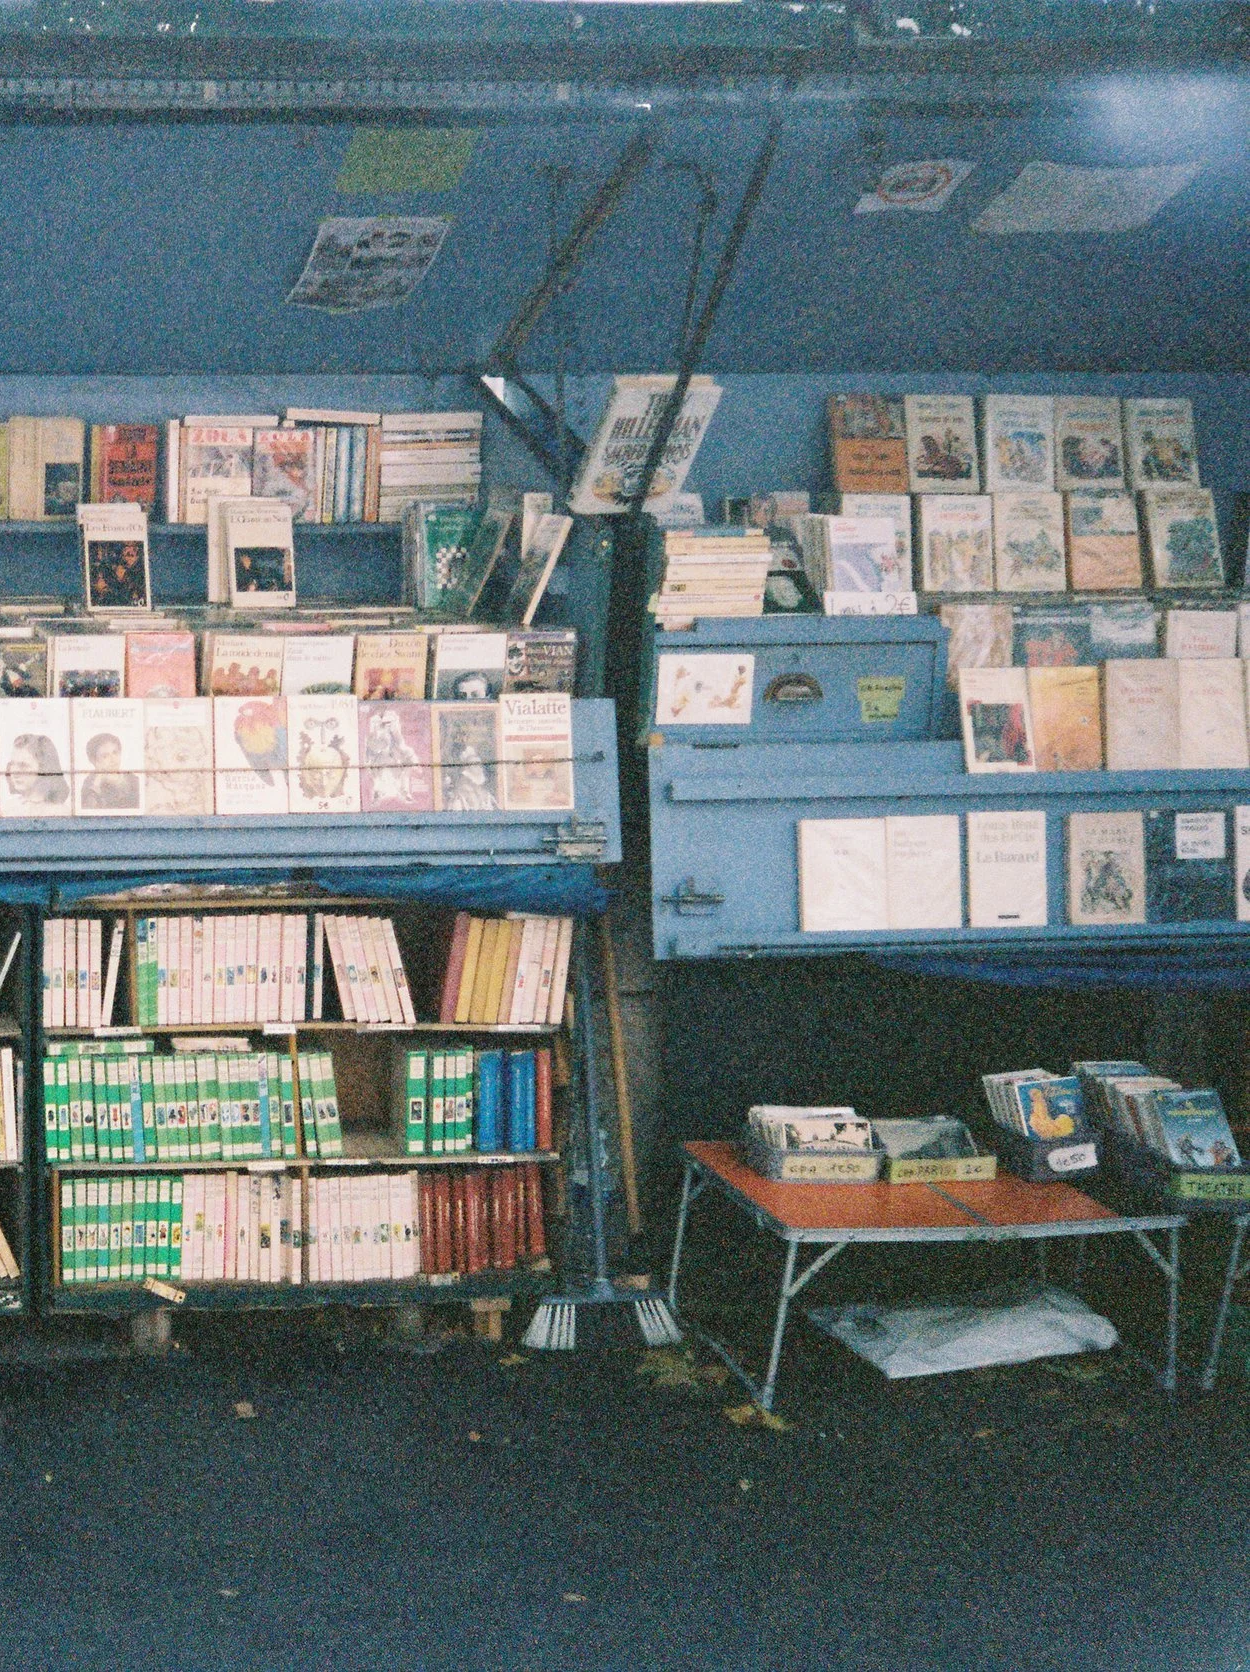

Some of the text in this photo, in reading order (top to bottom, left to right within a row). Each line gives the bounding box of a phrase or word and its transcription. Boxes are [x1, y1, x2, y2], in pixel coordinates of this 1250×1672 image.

[192, 428, 249, 444] ZOLA
[257, 430, 312, 443] ZOLA
[543, 644, 574, 657] VIAN
[504, 698, 568, 716] Vialatte
[81, 708, 137, 720] FLAUBERT
[976, 851, 1040, 864] Le Bavard
